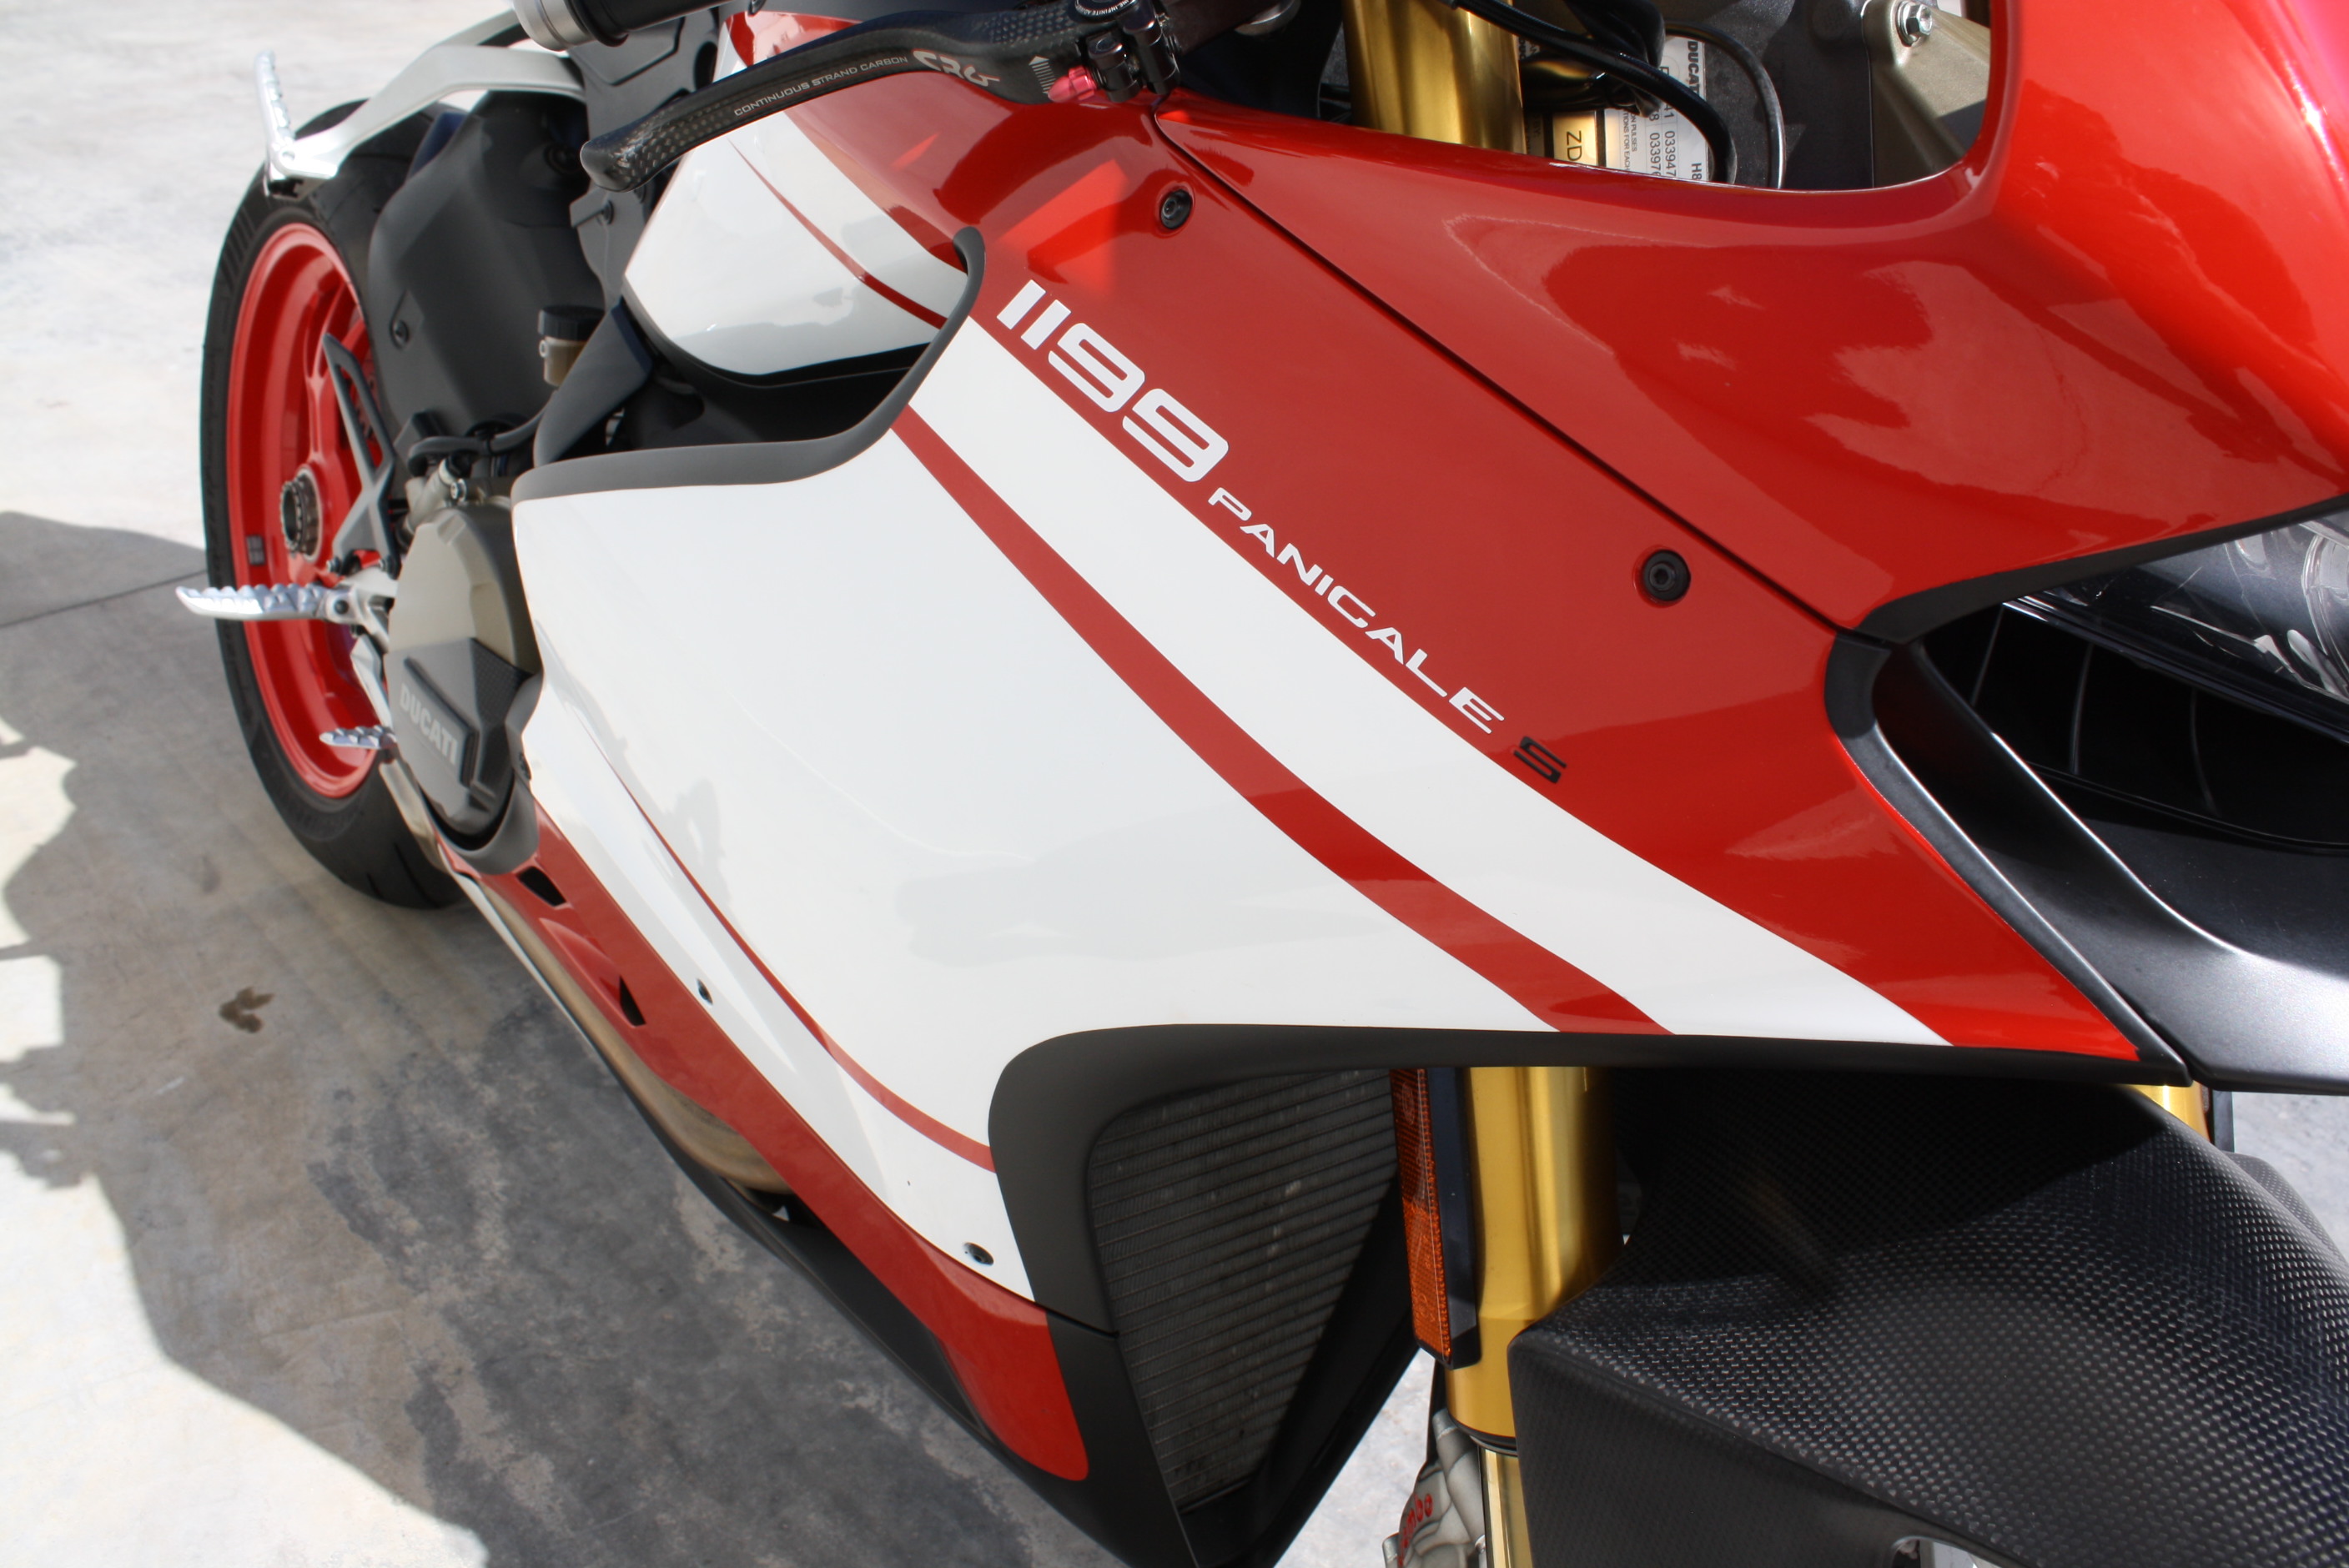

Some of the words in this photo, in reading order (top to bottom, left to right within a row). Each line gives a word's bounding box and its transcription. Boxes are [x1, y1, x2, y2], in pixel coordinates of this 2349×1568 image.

[734, 82, 810, 116] CONTINUOUS
[812, 66, 858, 86] STRAND
[860, 55, 908, 72] CARBON
[913, 49, 1000, 87] CRG
[1688, 41, 1700, 96] DUCAT
[1664, 130, 1677, 177] 033947
[997, 279, 1229, 482] 1199
[1208, 487, 1505, 734] PANIGALE
[1513, 736, 1567, 784] S
[400, 682, 458, 765] DUCATI
